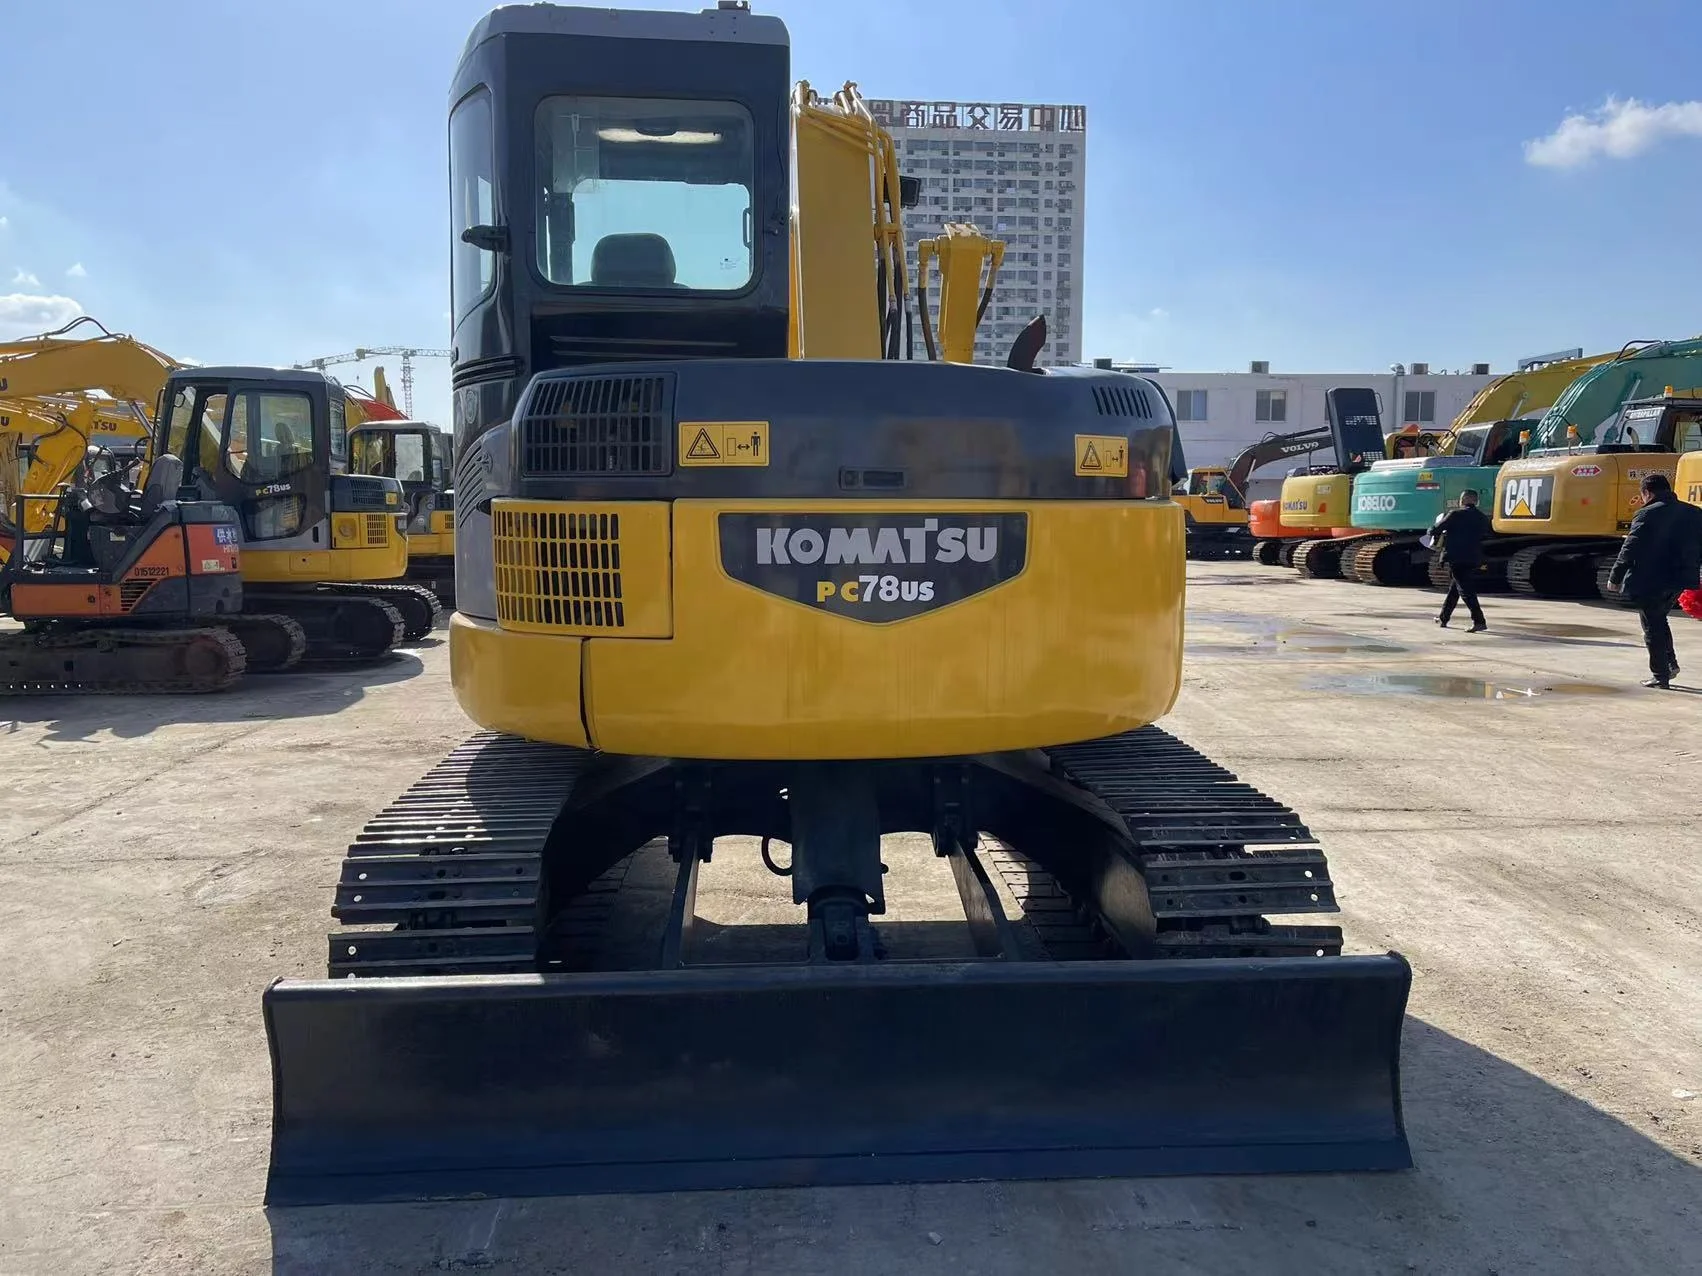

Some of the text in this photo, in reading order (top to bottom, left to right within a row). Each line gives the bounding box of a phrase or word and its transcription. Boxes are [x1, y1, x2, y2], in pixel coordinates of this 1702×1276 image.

[1281, 441, 1319, 453] VOLVO
[1504, 478, 1543, 516] CAT
[756, 518, 998, 565] KOMATSU
[816, 575, 935, 603] PC78US
